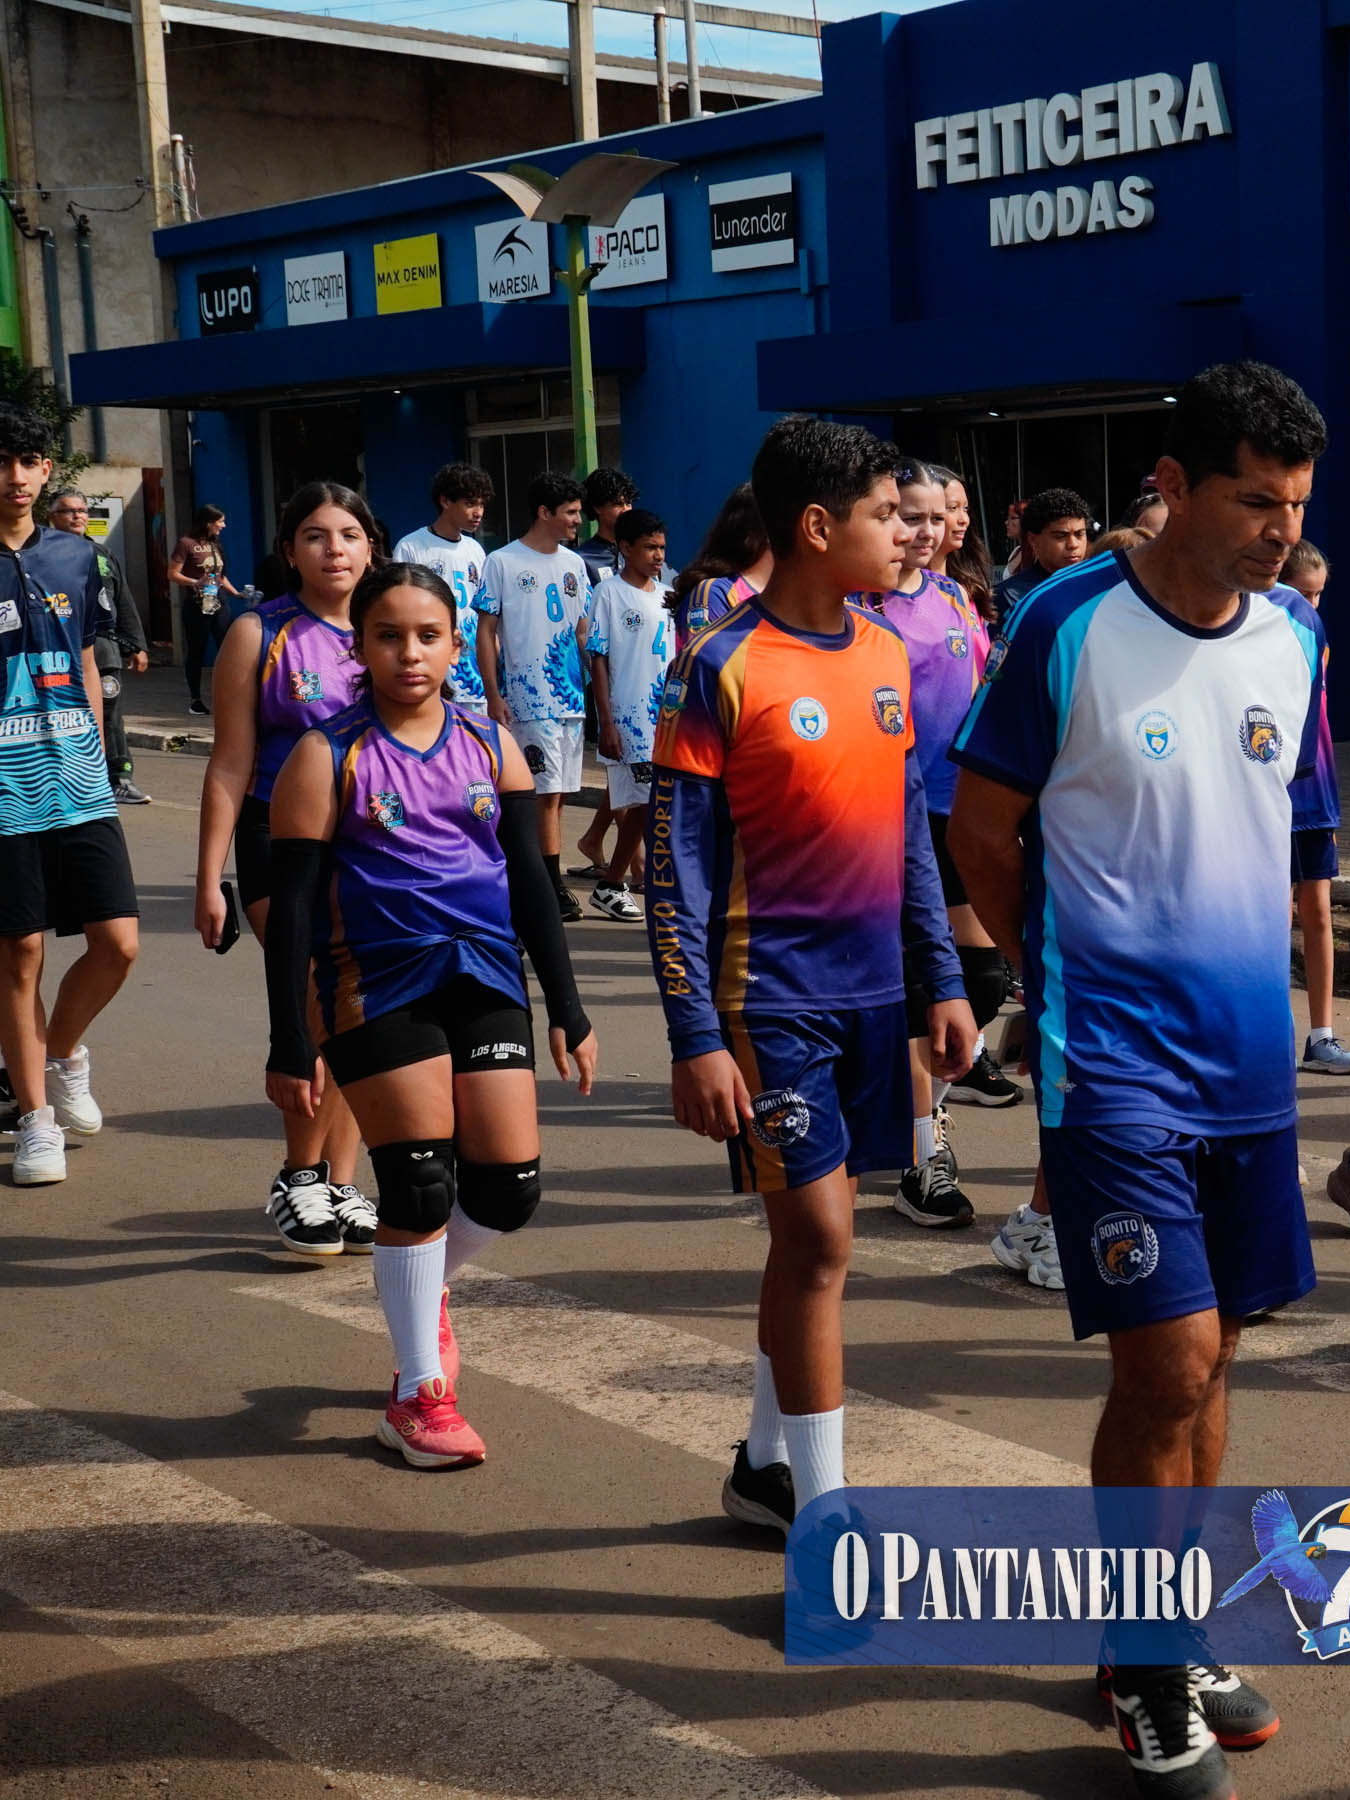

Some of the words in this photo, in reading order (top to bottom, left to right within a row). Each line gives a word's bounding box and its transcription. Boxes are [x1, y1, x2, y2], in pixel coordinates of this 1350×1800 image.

[914, 61, 1232, 190] FEITICEIRA
[714, 205, 787, 241] Lunender
[990, 175, 1154, 247] MODAS
[606, 224, 659, 260] PACO
[377, 270, 400, 286] MAX
[403, 264, 437, 282] DENIM
[618, 255, 646, 269] JEANS
[288, 278, 310, 304] DOCE
[312, 274, 344, 301] TRAMA
[489, 273, 539, 298] MARESIA
[201, 285, 251, 325] LUPO
[453, 571, 468, 610] 5
[545, 583, 564, 622] 8
[652, 621, 666, 662] 4
[468, 785, 494, 796] BONITO
[653, 902, 691, 996] BONITO
[471, 1044, 490, 1059] LOS
[491, 1042, 526, 1057] ANGELES
[1098, 1217, 1139, 1240] BONITO
